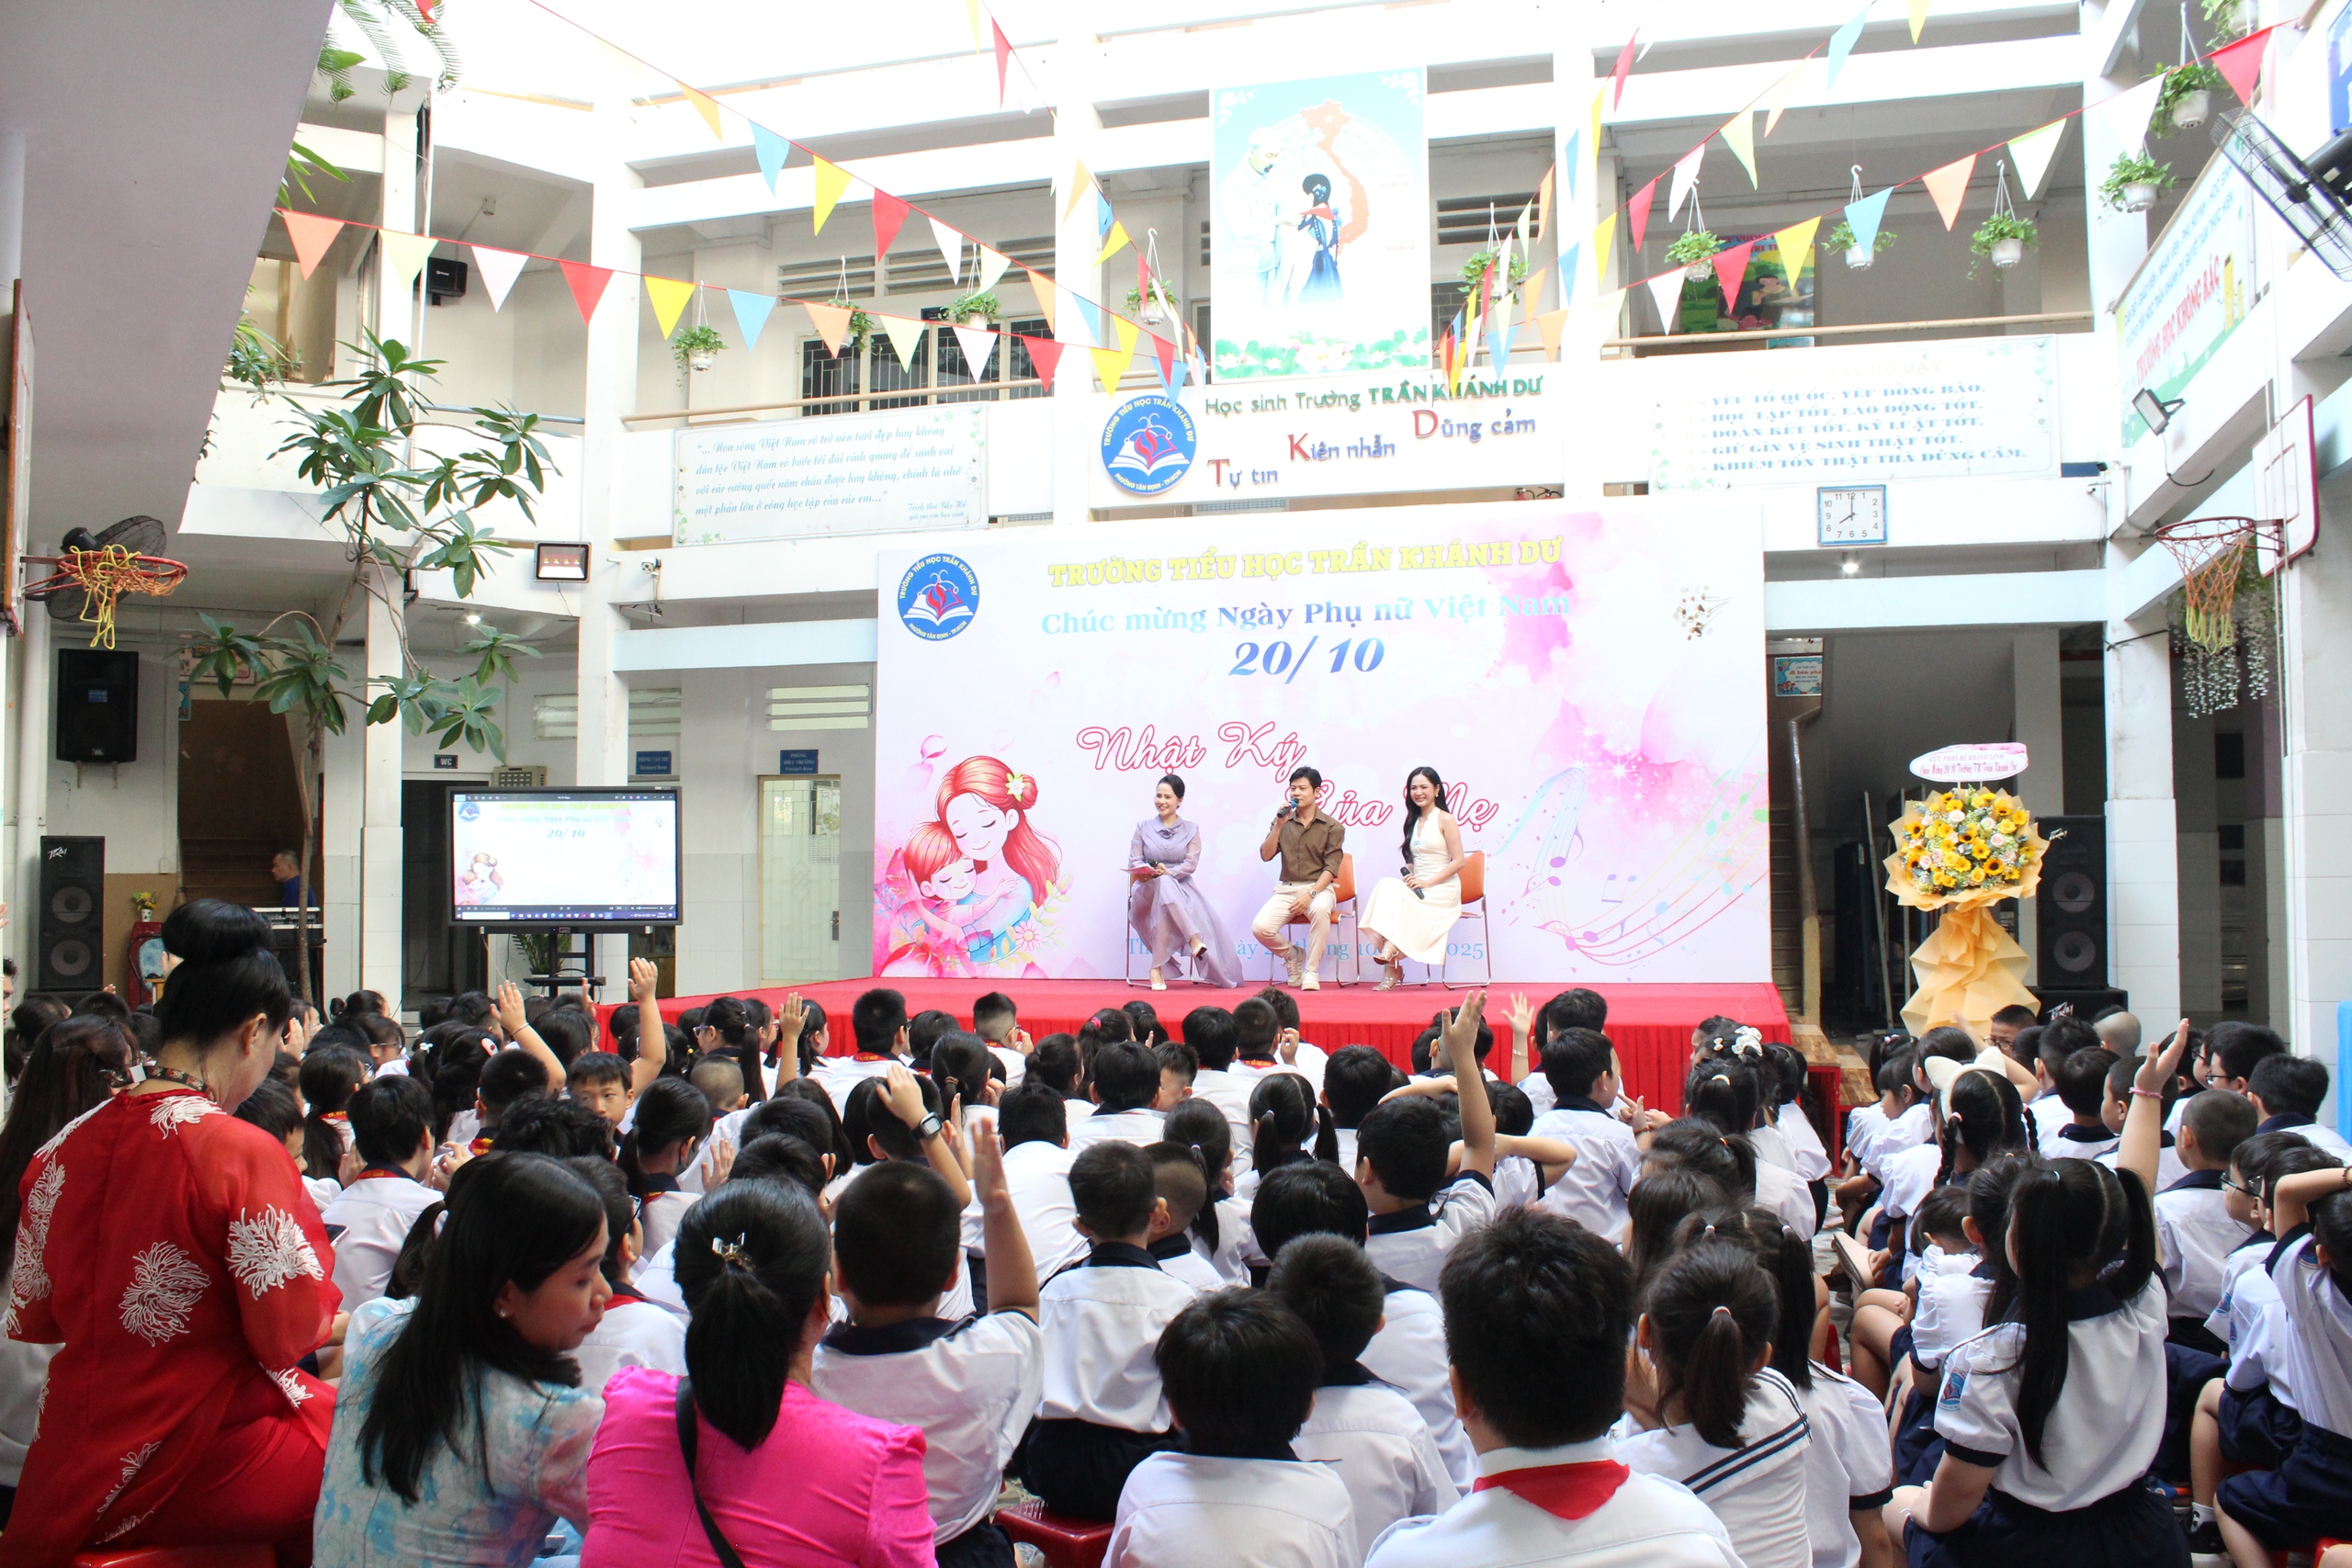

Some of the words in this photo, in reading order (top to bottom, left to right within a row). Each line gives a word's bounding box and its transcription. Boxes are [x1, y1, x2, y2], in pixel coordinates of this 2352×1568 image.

[2135, 330, 2161, 386] TRƯỜNG
[2161, 310, 2176, 355] HỌC
[2176, 276, 2201, 336] KHÔNG
[2202, 252, 2219, 303] RÁC
[1205, 398, 1242, 419] Học
[1250, 393, 1287, 413] sinh
[1295, 389, 1361, 412] Trường
[1368, 379, 1428, 405] TRẦN
[1513, 374, 1544, 397] DƯ
[1712, 394, 1746, 405] YÊU
[1104, 415, 1120, 446] TRƯỜNG
[1118, 404, 1133, 416] TIỂU
[1134, 398, 1151, 408] HỌC
[1186, 430, 1195, 443] DƯ
[1411, 409, 1482, 442] Dũng
[1491, 408, 1536, 434] cảm
[1712, 412, 1748, 423] HỌC
[1756, 408, 1792, 423] TẬP
[1842, 406, 1879, 416] LAO
[1770, 422, 1806, 435] KẾT
[1888, 417, 1938, 432] LUẬT
[713, 441, 733, 453] Non
[736, 441, 756, 454] sông
[759, 437, 780, 451] Việt
[782, 435, 806, 447] Nam
[808, 435, 819, 446] có
[820, 433, 834, 445] trở
[836, 433, 853, 444] nên
[855, 430, 873, 441] tươi
[875, 429, 892, 443] đẹp
[895, 427, 912, 439] hay
[915, 425, 944, 440] không
[1287, 432, 1340, 462] Kiên
[1346, 434, 1396, 459] nhẫn
[1749, 441, 1781, 453] GÌN
[1788, 439, 1811, 454] VỆ
[1816, 439, 1860, 449] SINH
[1866, 434, 1917, 449] THẬT
[695, 464, 713, 475] dân
[715, 463, 728, 476] tộc
[730, 460, 752, 474] Việt
[753, 458, 777, 470] Nam
[779, 457, 789, 468] có
[792, 456, 811, 468] bước
[813, 454, 827, 466] tới
[828, 452, 843, 464] đài
[845, 450, 865, 463] vinh
[868, 451, 898, 463] quang
[914, 446, 936, 457] sánh
[939, 445, 955, 456] vai
[1207, 458, 1243, 489] Tự
[1250, 468, 1279, 485] tin
[1713, 458, 1774, 471] KHIÊM
[1822, 453, 1871, 468] THẬT
[1876, 451, 1916, 464] THÀ
[711, 483, 725, 494] các
[727, 482, 753, 493] cường
[755, 478, 776, 492] quốc
[777, 479, 798, 489] năm
[800, 476, 821, 488] châu
[824, 474, 845, 488] được
[847, 471, 865, 485] hay
[867, 470, 899, 482] không,
[902, 467, 928, 479] chính
[931, 467, 941, 478] là
[943, 465, 962, 477] nhờ
[1114, 473, 1136, 489] PHƯỜNG
[695, 503, 713, 517] một
[714, 502, 738, 517] phần
[763, 499, 785, 513] công
[787, 497, 803, 511] học
[805, 496, 820, 510] tập
[823, 494, 839, 506] của
[841, 493, 855, 505] các
[1824, 500, 1833, 508] 10
[1872, 498, 1878, 506] 2
[1048, 557, 1161, 587] TRƯỜNG
[1168, 546, 1237, 581] TIỂU
[1242, 551, 1303, 581] HỌC
[1308, 540, 1393, 574] TRẦN
[1398, 538, 1512, 570] KHÁNH
[1519, 535, 1565, 565] DƯ
[899, 571, 914, 600] TRƯỜNG
[926, 556, 942, 565] HỌC
[958, 563, 976, 585] KHÁNH
[1042, 609, 1114, 634] Chúc
[1125, 607, 1207, 634] mừng
[1216, 601, 1294, 631] Ngày
[1303, 601, 1363, 627] Phụ
[1373, 596, 1415, 621] nữ
[1424, 592, 1488, 624] Việt
[1498, 593, 1572, 617] Nam
[440, 758, 453, 766] WC
[1076, 723, 1207, 775] Nhật
[1217, 720, 1307, 784] Ký
